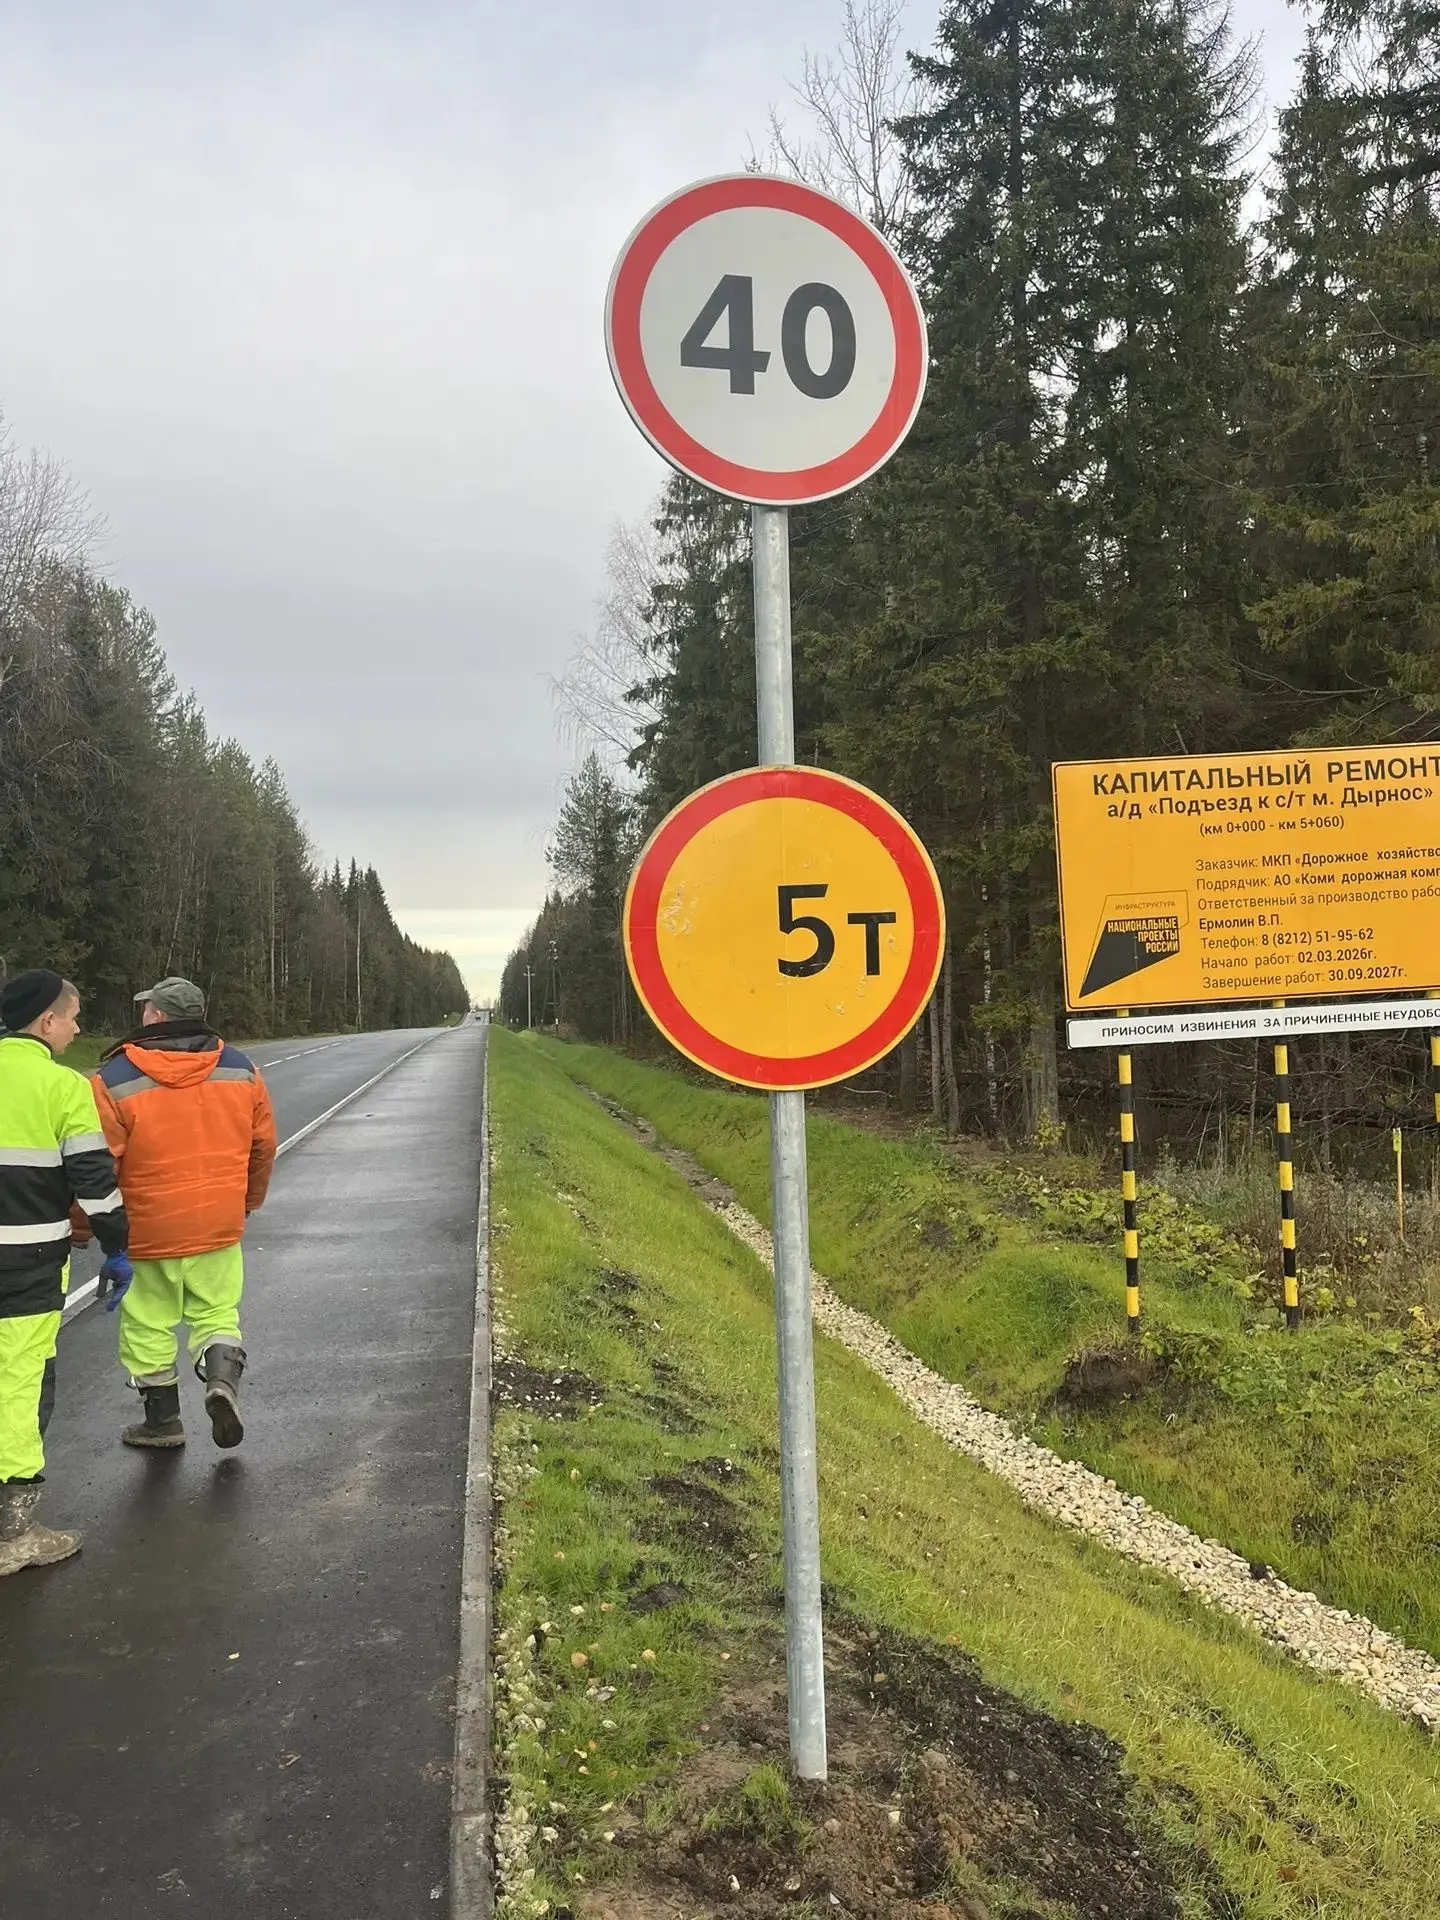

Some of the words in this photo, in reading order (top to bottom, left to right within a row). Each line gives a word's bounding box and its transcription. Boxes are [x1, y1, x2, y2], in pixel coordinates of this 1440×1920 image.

[680, 274, 857, 400] 40
[1093, 760, 1312, 796] КАПИТАЛЬНЫЙ
[1327, 756, 1440, 783] РЕМОНТ
[1107, 800, 1142, 820] а/д
[1149, 796, 1252, 817] «Подъезд
[1258, 795, 1270, 809] к
[1275, 791, 1305, 809] с/т
[1312, 792, 1334, 807] м.
[1341, 787, 1433, 808] Дырнос»
[1199, 823, 1223, 837] (км
[1226, 820, 1266, 834] 0+000
[1278, 819, 1296, 831] км
[1300, 816, 1344, 832] 5+060)
[1195, 858, 1258, 871] Заказчик:
[1261, 854, 1292, 867] МКП
[1295, 851, 1369, 867] «Дорожное
[1196, 877, 1271, 892] Подрядчик:
[1273, 873, 1291, 886] АО
[1294, 872, 1335, 885] «Коми
[1341, 869, 1407, 884] дорожная
[1115, 900, 1176, 911] ИНФРАСТРУКТУРА
[1197, 892, 1297, 911] Ответственный
[1300, 894, 1315, 905] за
[1317, 889, 1408, 906] производство
[1107, 917, 1177, 933] НАЦИОНАЛЬНЫЕ
[1199, 917, 1255, 932] Ермолин
[1257, 913, 1284, 927] В.П.
[1137, 929, 1178, 942] ПРОЕКТЫ
[1201, 935, 1258, 950] Телефон:
[1261, 933, 1270, 946] 8
[1272, 930, 1312, 948] (8212)
[1315, 927, 1374, 943] 51-95-62
[1145, 940, 1179, 954] РОССИИ
[1201, 957, 1248, 969] Начало
[1255, 952, 1295, 969] работ:
[1297, 947, 1377, 964] 02.03.2026г.
[1203, 974, 1281, 990] Завершение
[1285, 970, 1326, 987] работ:
[1328, 965, 1408, 982] 30.09.2027г.
[1102, 1024, 1174, 1037] ПРИНОСИМ
[1180, 1019, 1257, 1033] ИЗВИНЕНИЯ
[1263, 1017, 1281, 1028] ЗА
[1284, 1012, 1381, 1026] ПРИЧИНЕННЫЕ
